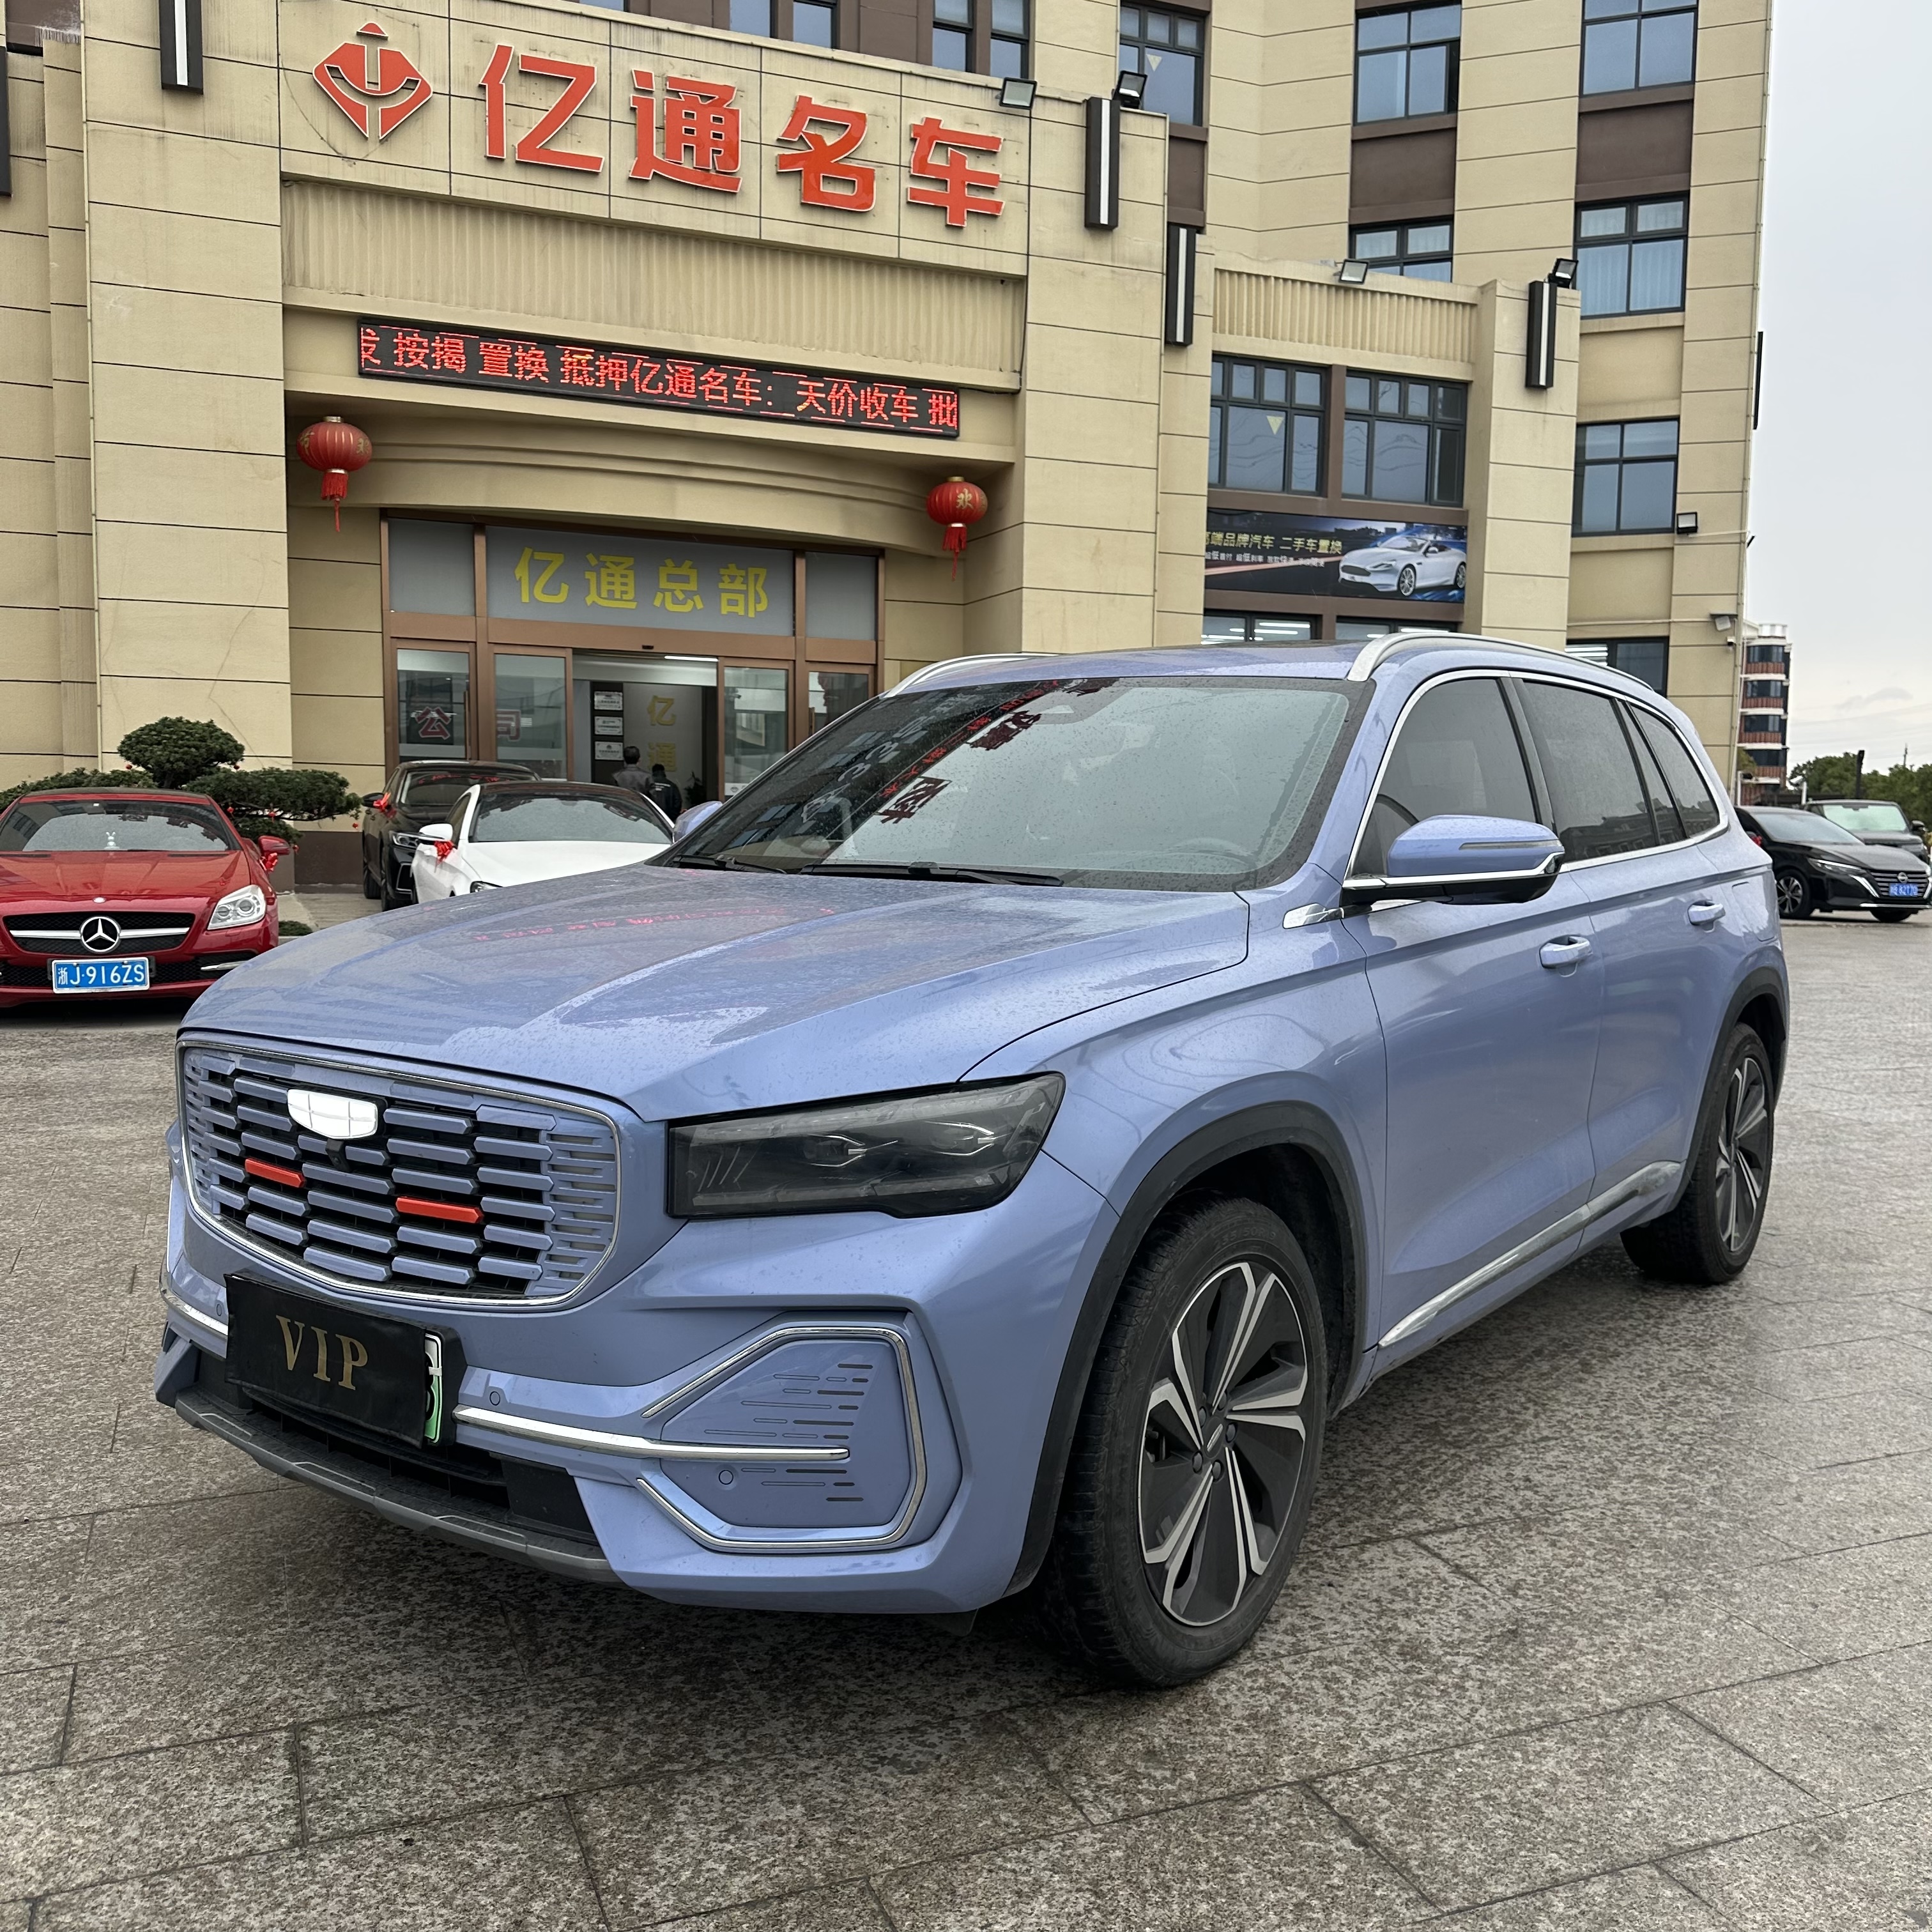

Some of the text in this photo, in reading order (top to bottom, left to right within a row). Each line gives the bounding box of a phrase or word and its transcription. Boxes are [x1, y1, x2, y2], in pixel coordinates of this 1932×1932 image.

[478, 44, 1006, 228] 亿通名车
[394, 330, 467, 373] 按揭
[478, 342, 550, 383] 置换
[796, 380, 919, 423] 天价收车
[514, 546, 767, 618] 亿通总部
[647, 694, 677, 772] 亿通
[276, 1314, 368, 1391] VIP
